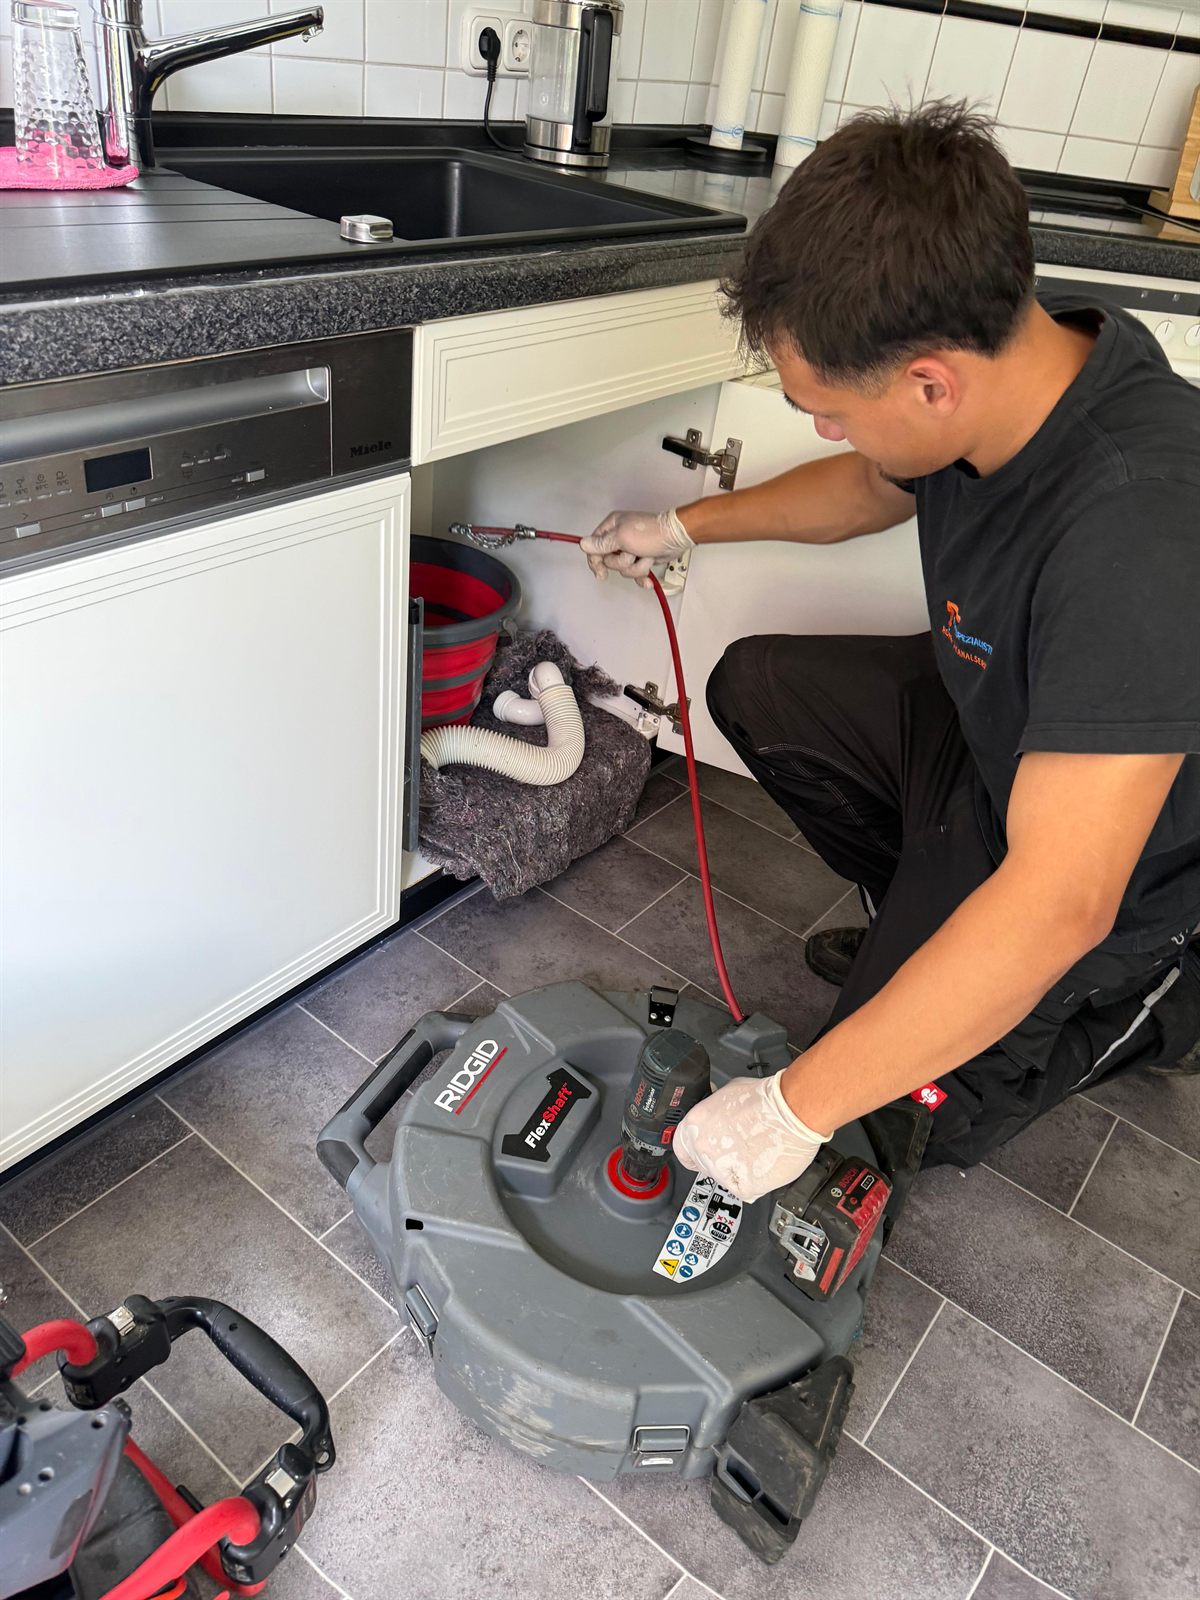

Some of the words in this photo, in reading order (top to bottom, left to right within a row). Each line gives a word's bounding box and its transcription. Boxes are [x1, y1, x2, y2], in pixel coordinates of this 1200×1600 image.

[350, 441, 392, 458] Miele
[433, 1039, 499, 1113] RIDGID
[838, 1167, 858, 1189] BOSCH
